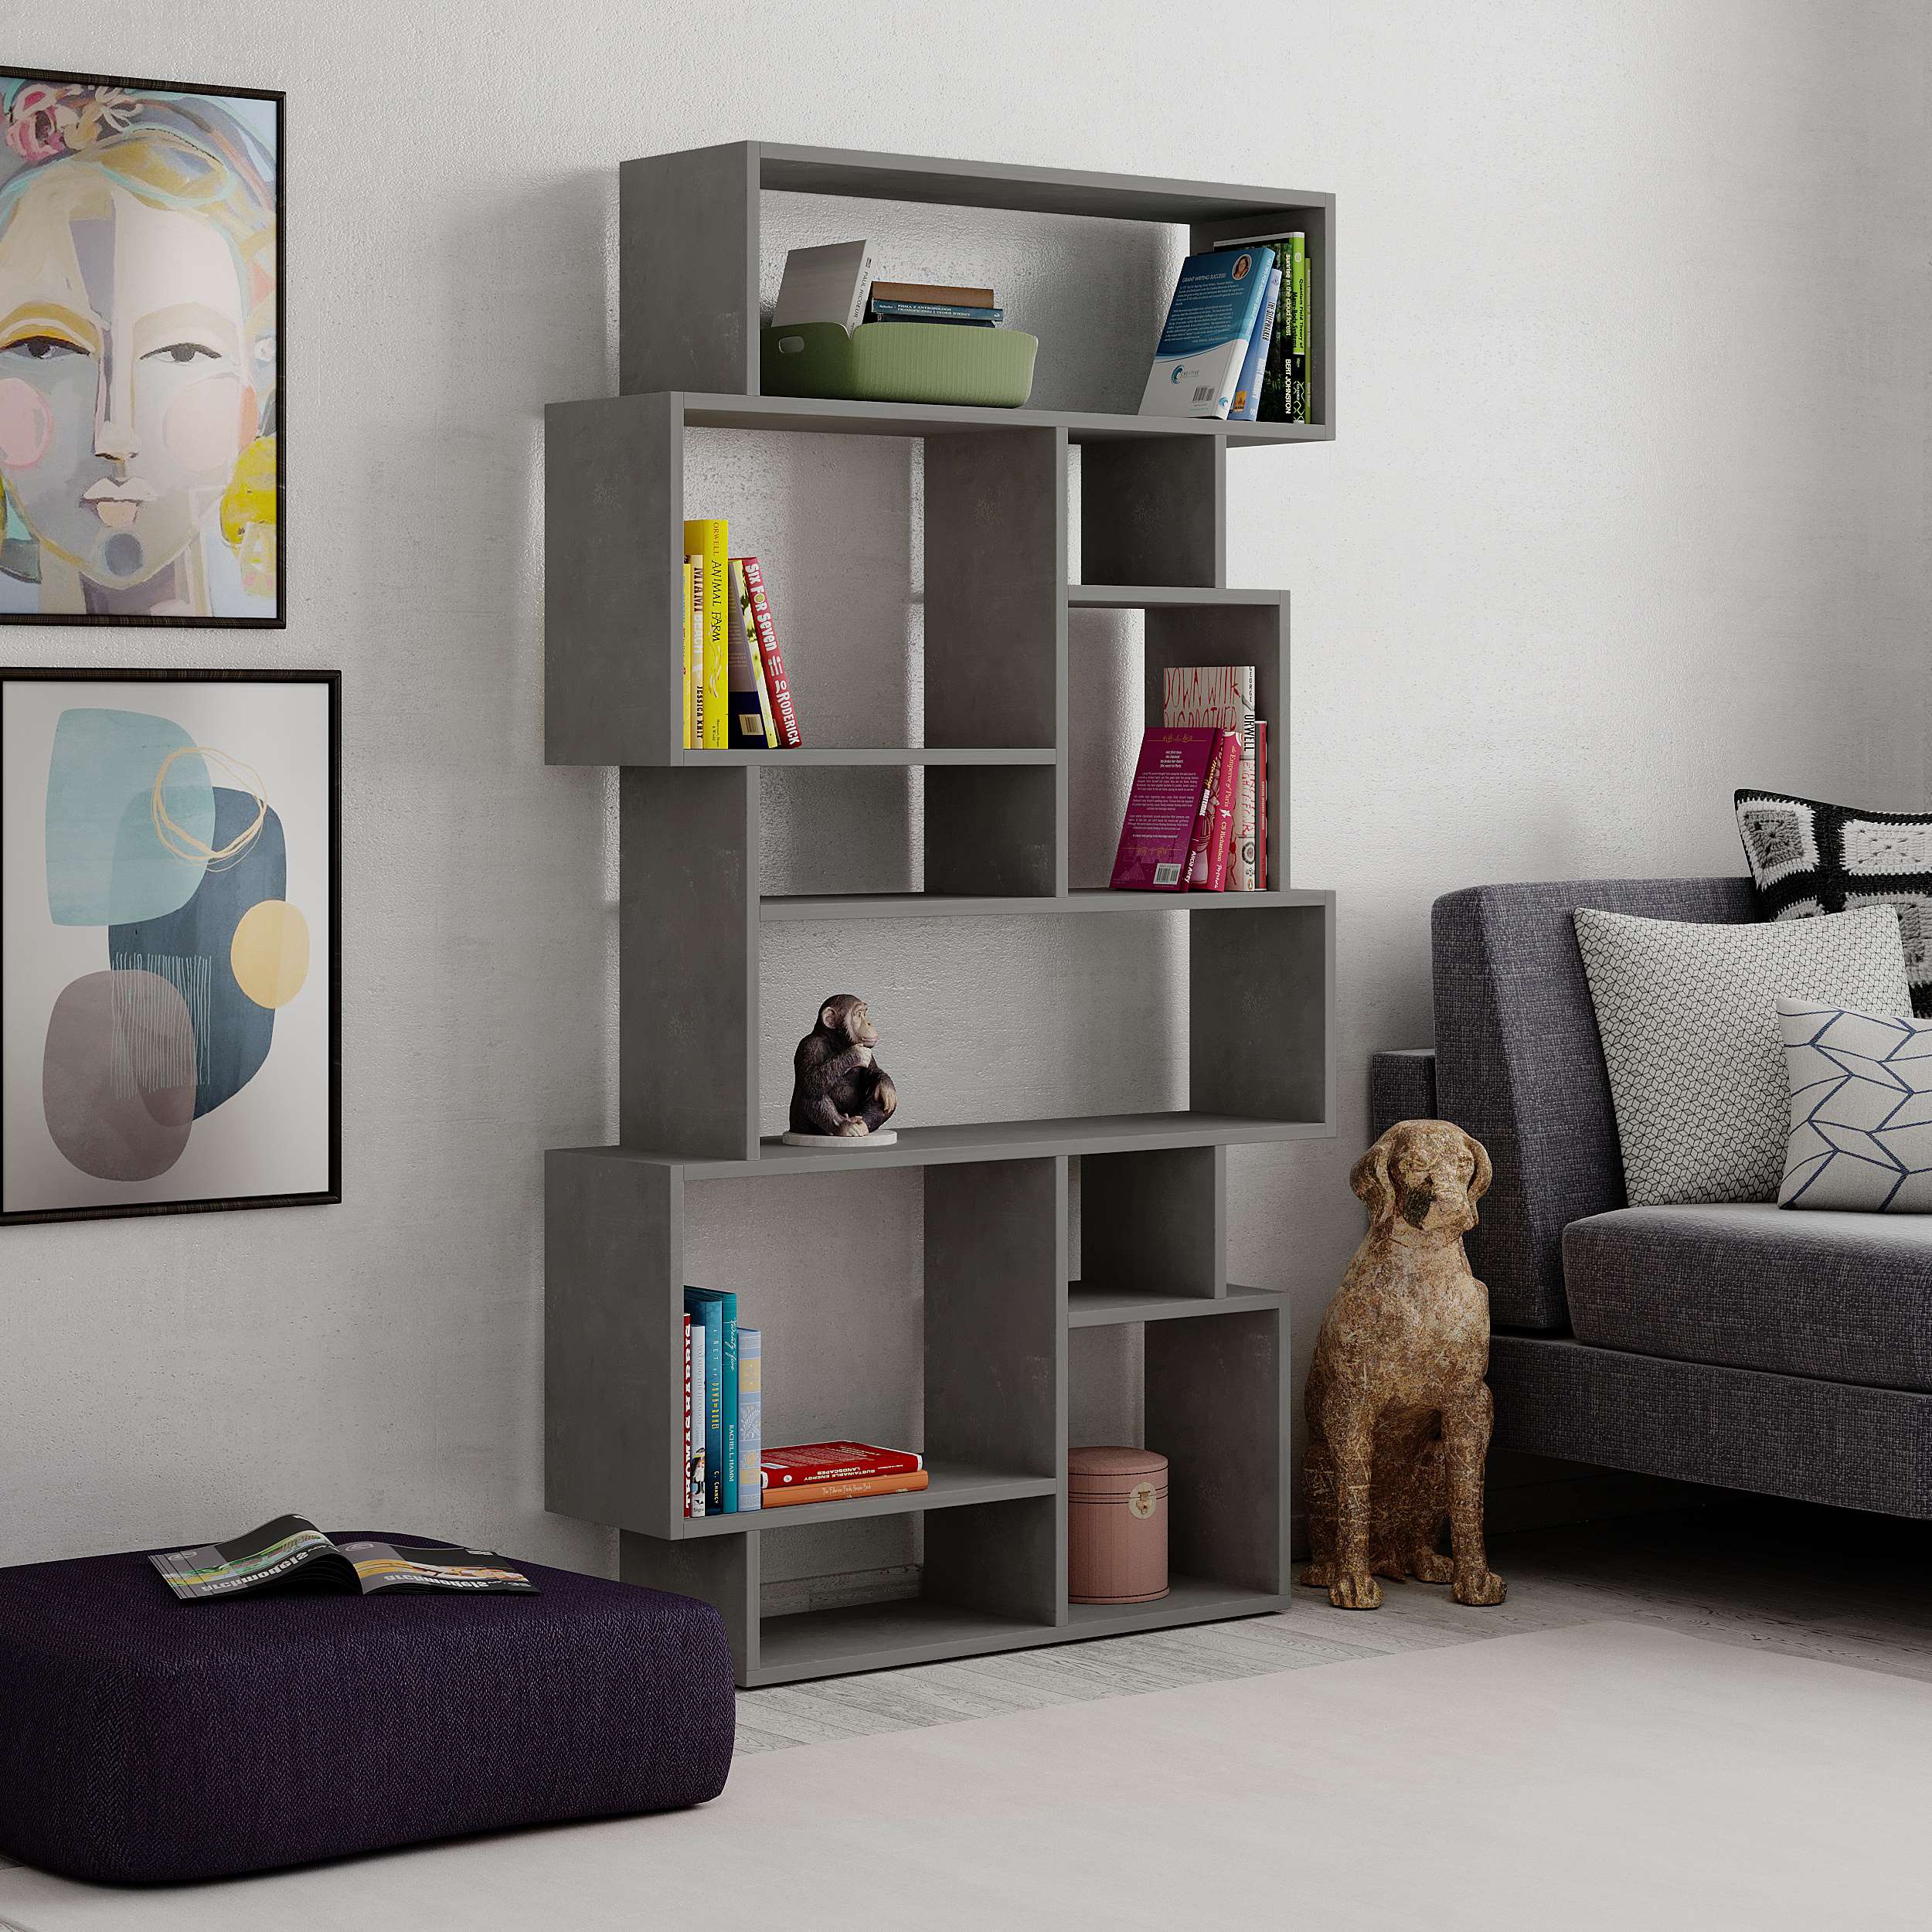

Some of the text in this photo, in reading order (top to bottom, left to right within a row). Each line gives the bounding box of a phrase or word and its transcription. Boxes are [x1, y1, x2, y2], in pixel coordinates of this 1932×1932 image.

[859, 270, 869, 290] PAUL
[852, 290, 864, 318] RICOEUR
[1261, 301, 1276, 342] THE SLEEPWALKER
[744, 563, 760, 582] SIX
[693, 567, 703, 613] MIAMI
[711, 560, 723, 641] ANIMAL FARM
[751, 584, 767, 613] FOR
[1163, 667, 1203, 710] DOWN
[775, 692, 800, 746] RODERICK
[1244, 714, 1255, 752] ORWELL
[1226, 754, 1236, 784] Emperor
[1216, 831, 1226, 862] Richardson
[1184, 850, 1196, 883] Alicia Airey
[817, 1467, 860, 1475] LANDSCAPES
[832, 1469, 876, 1478] SUSTAINABLE
